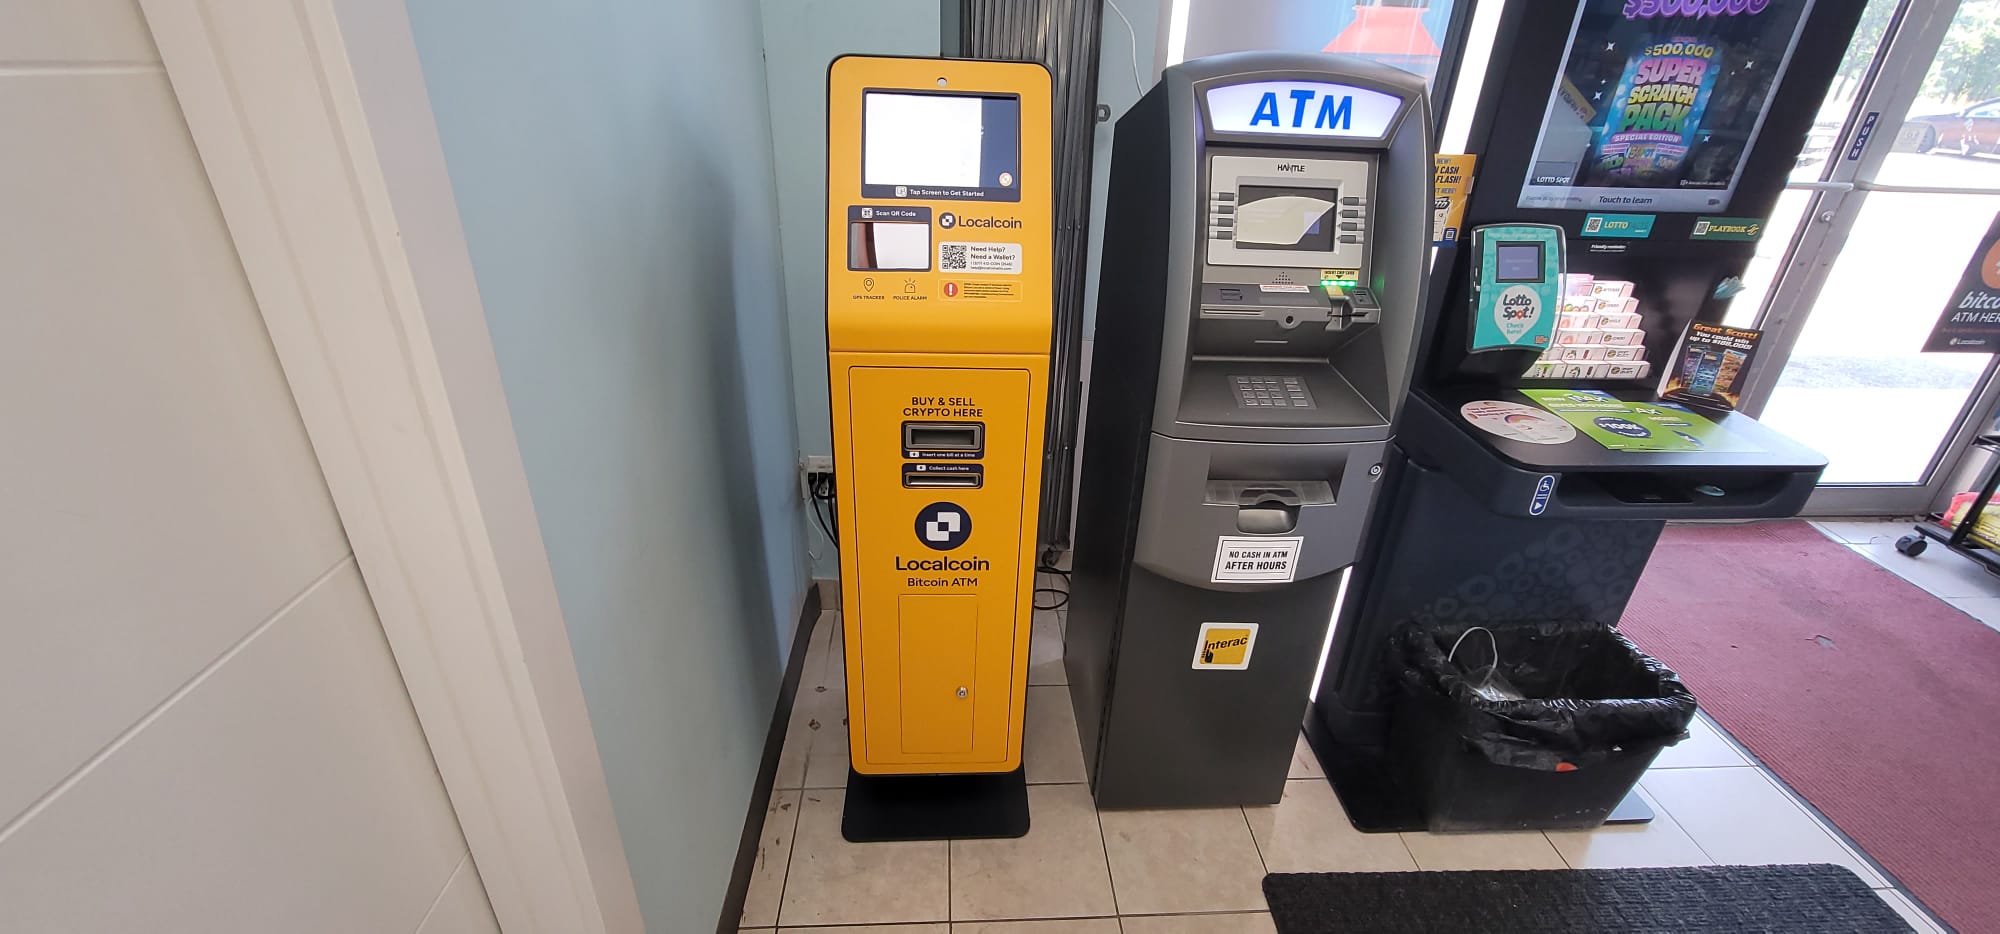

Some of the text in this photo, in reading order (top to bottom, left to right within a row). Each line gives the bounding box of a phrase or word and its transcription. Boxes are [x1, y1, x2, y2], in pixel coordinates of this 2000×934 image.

[1644, 43, 1714, 58] $500,000
[1634, 57, 1708, 85] SUPER
[1629, 83, 1699, 105] SCRATCH
[1249, 89, 1353, 130] ATM
[1620, 103, 1692, 133] PACK
[1615, 133, 1679, 143] SPECIAL EDITION
[1851, 115, 1875, 158] PUSH
[1440, 166, 1460, 175] CASH
[1435, 176, 1461, 184] FLASH!
[1599, 195, 1622, 204] Touch
[1632, 196, 1653, 204] learn
[958, 215, 1022, 229] Localcoin
[1604, 221, 1629, 229] LOTTO
[1708, 225, 1747, 233] PLAYBOOK
[1503, 294, 1532, 306] Lotto
[1950, 311, 1980, 322] ATM
[1692, 323, 1760, 340] Great Scott!
[1711, 334, 1734, 342] could
[911, 396, 976, 407] BUY & SELL
[902, 407, 983, 417] CRYPTO HERE
[1241, 551, 1261, 559] CASH
[895, 556, 990, 571] Localcoin
[1225, 561, 1287, 570] AFTER HOURS
[907, 577, 978, 587] Bitcoin ATM
[1204, 636, 1248, 651] Interac
